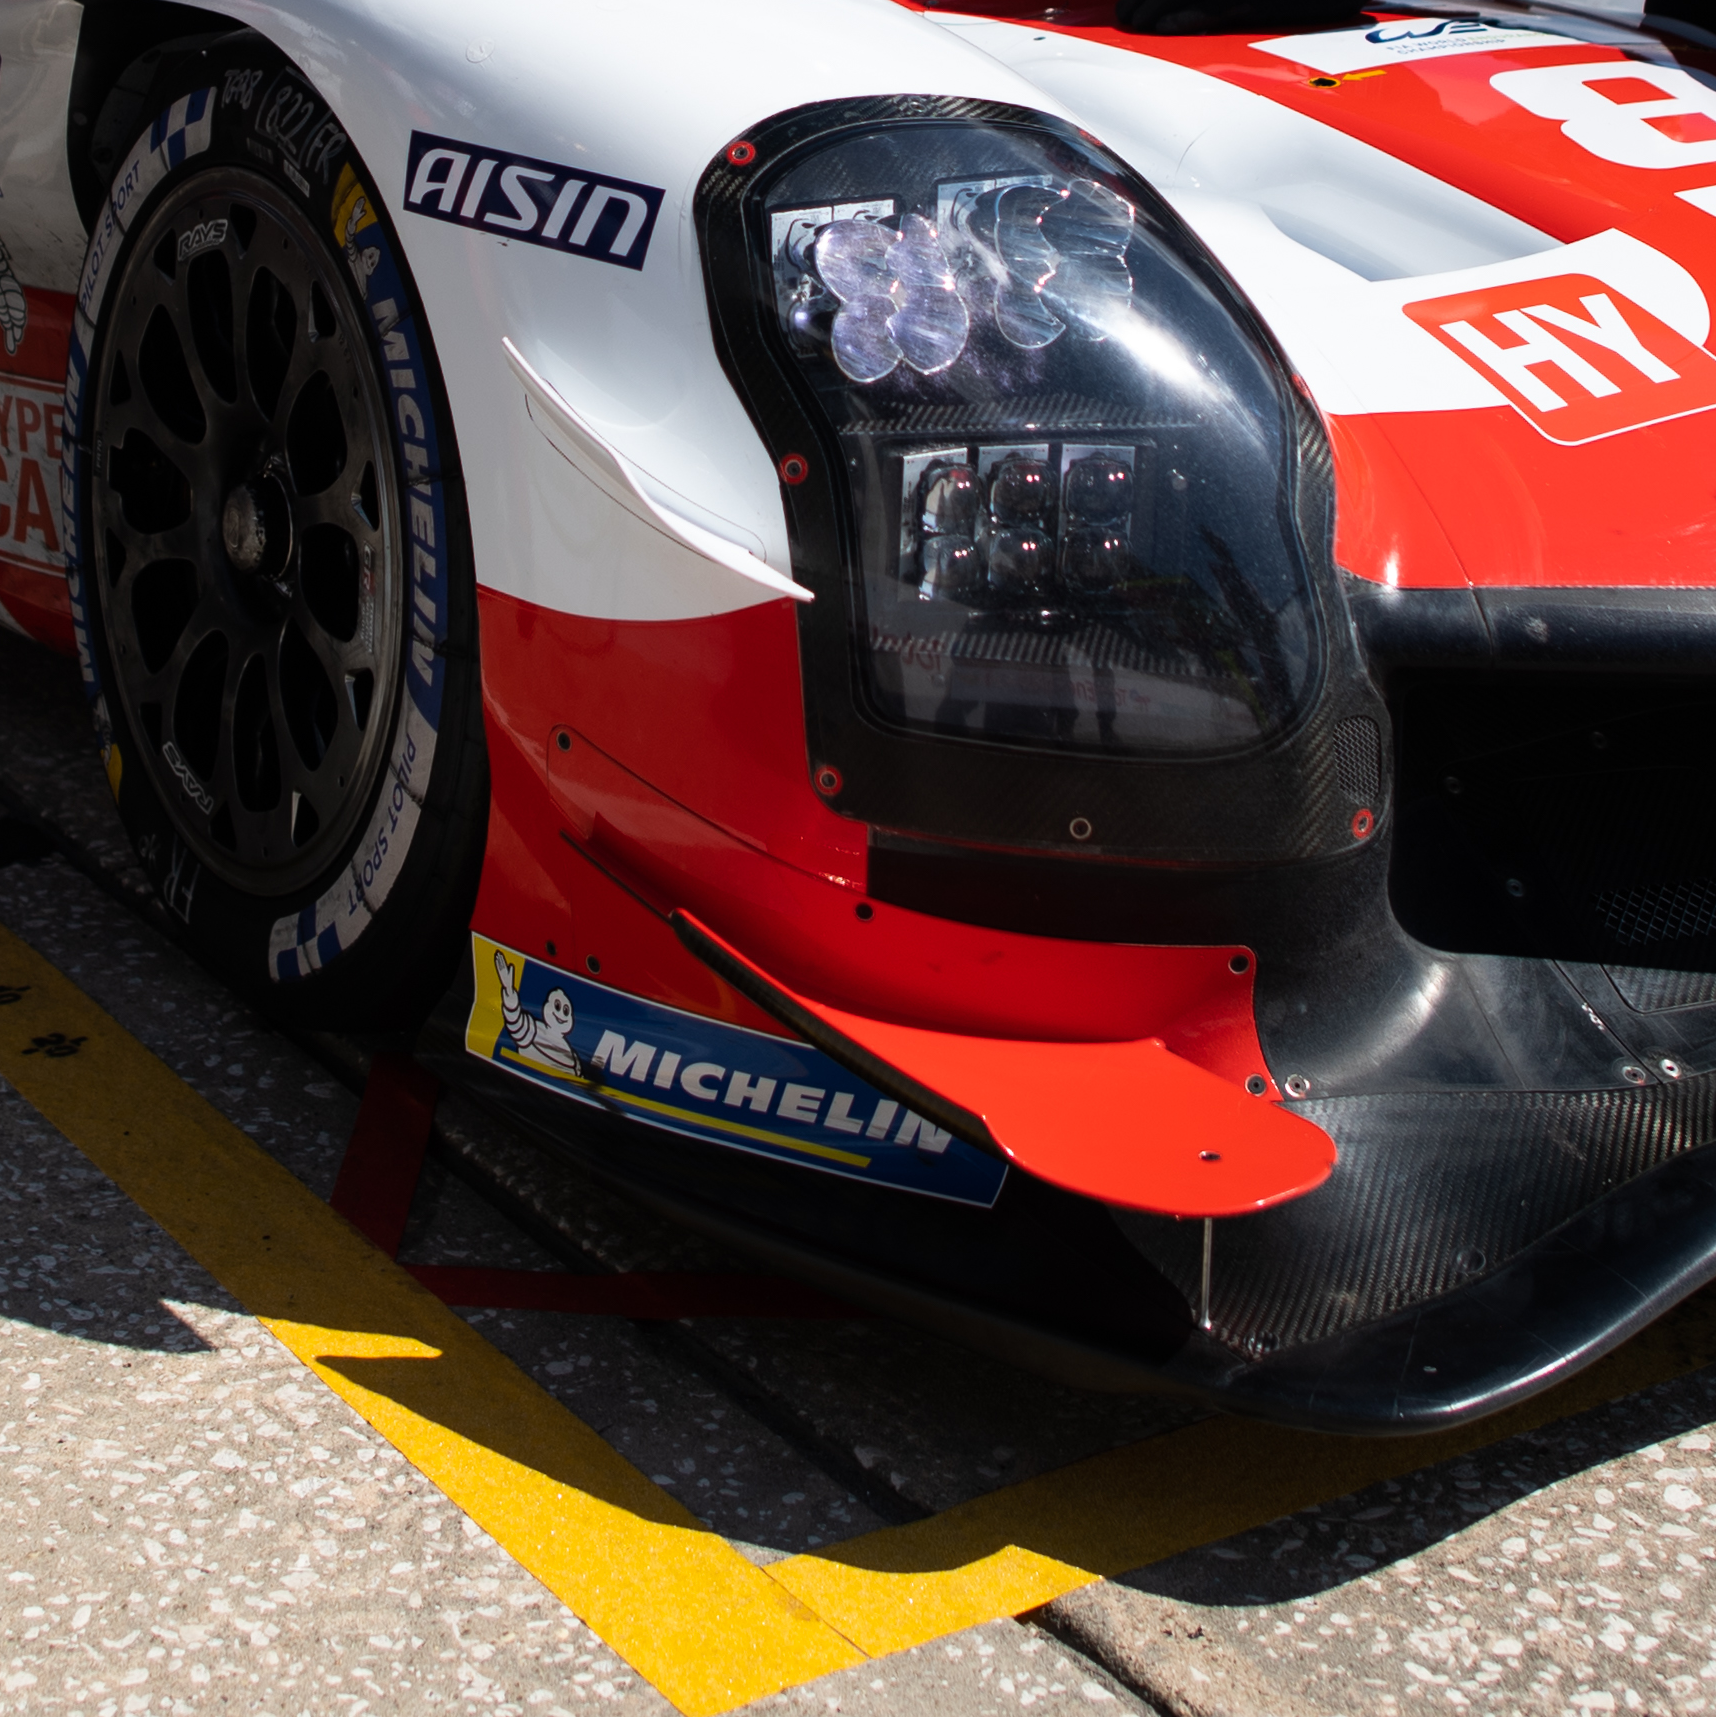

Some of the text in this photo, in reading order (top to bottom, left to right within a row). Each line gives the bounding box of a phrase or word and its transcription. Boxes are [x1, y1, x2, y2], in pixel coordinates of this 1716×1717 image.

[80, 163, 141, 313] PILOT SPORT
[177, 219, 229, 262] RAYS
[408, 148, 648, 257] AISIN
[1440, 292, 1682, 412] HY
[373, 297, 437, 687] MICHELIN
[161, 740, 215, 815] RAYS
[348, 734, 417, 917] PILOT SPORT
[592, 1029, 953, 1154] MICHELIN
